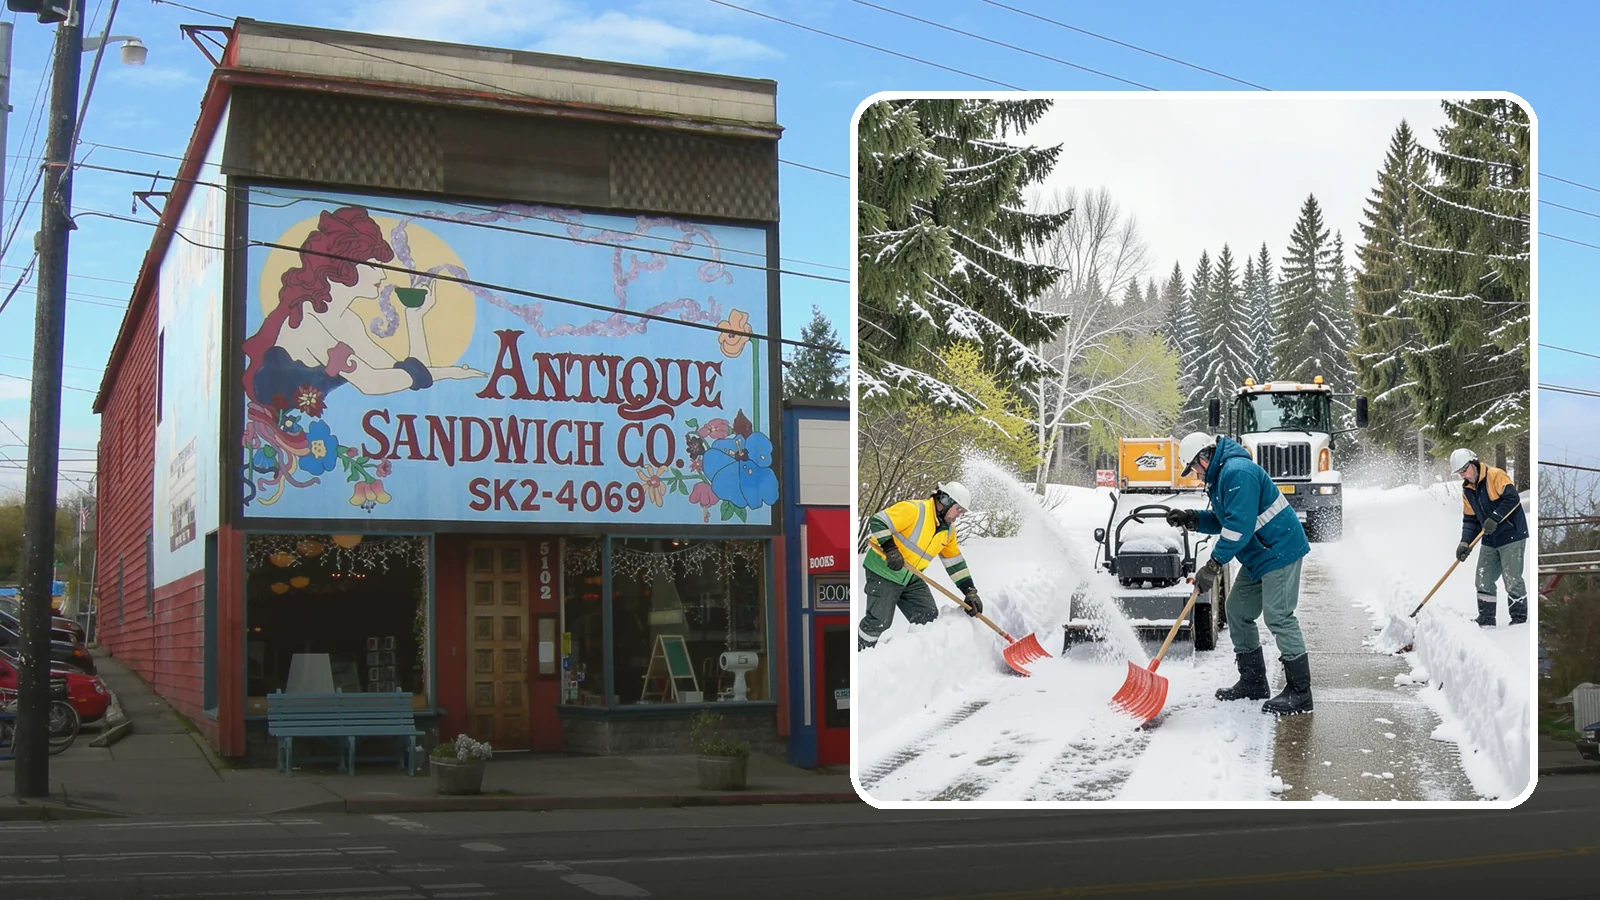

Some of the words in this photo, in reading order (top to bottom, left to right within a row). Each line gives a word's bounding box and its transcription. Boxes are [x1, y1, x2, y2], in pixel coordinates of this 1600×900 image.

[476, 329, 723, 421] ANTIQUE
[361, 408, 606, 467] SANDWICH
[617, 422, 685, 469] CO.
[468, 478, 645, 513] SK2-4069
[540, 541, 551, 599] 5102
[809, 555, 834, 568] BOOKS
